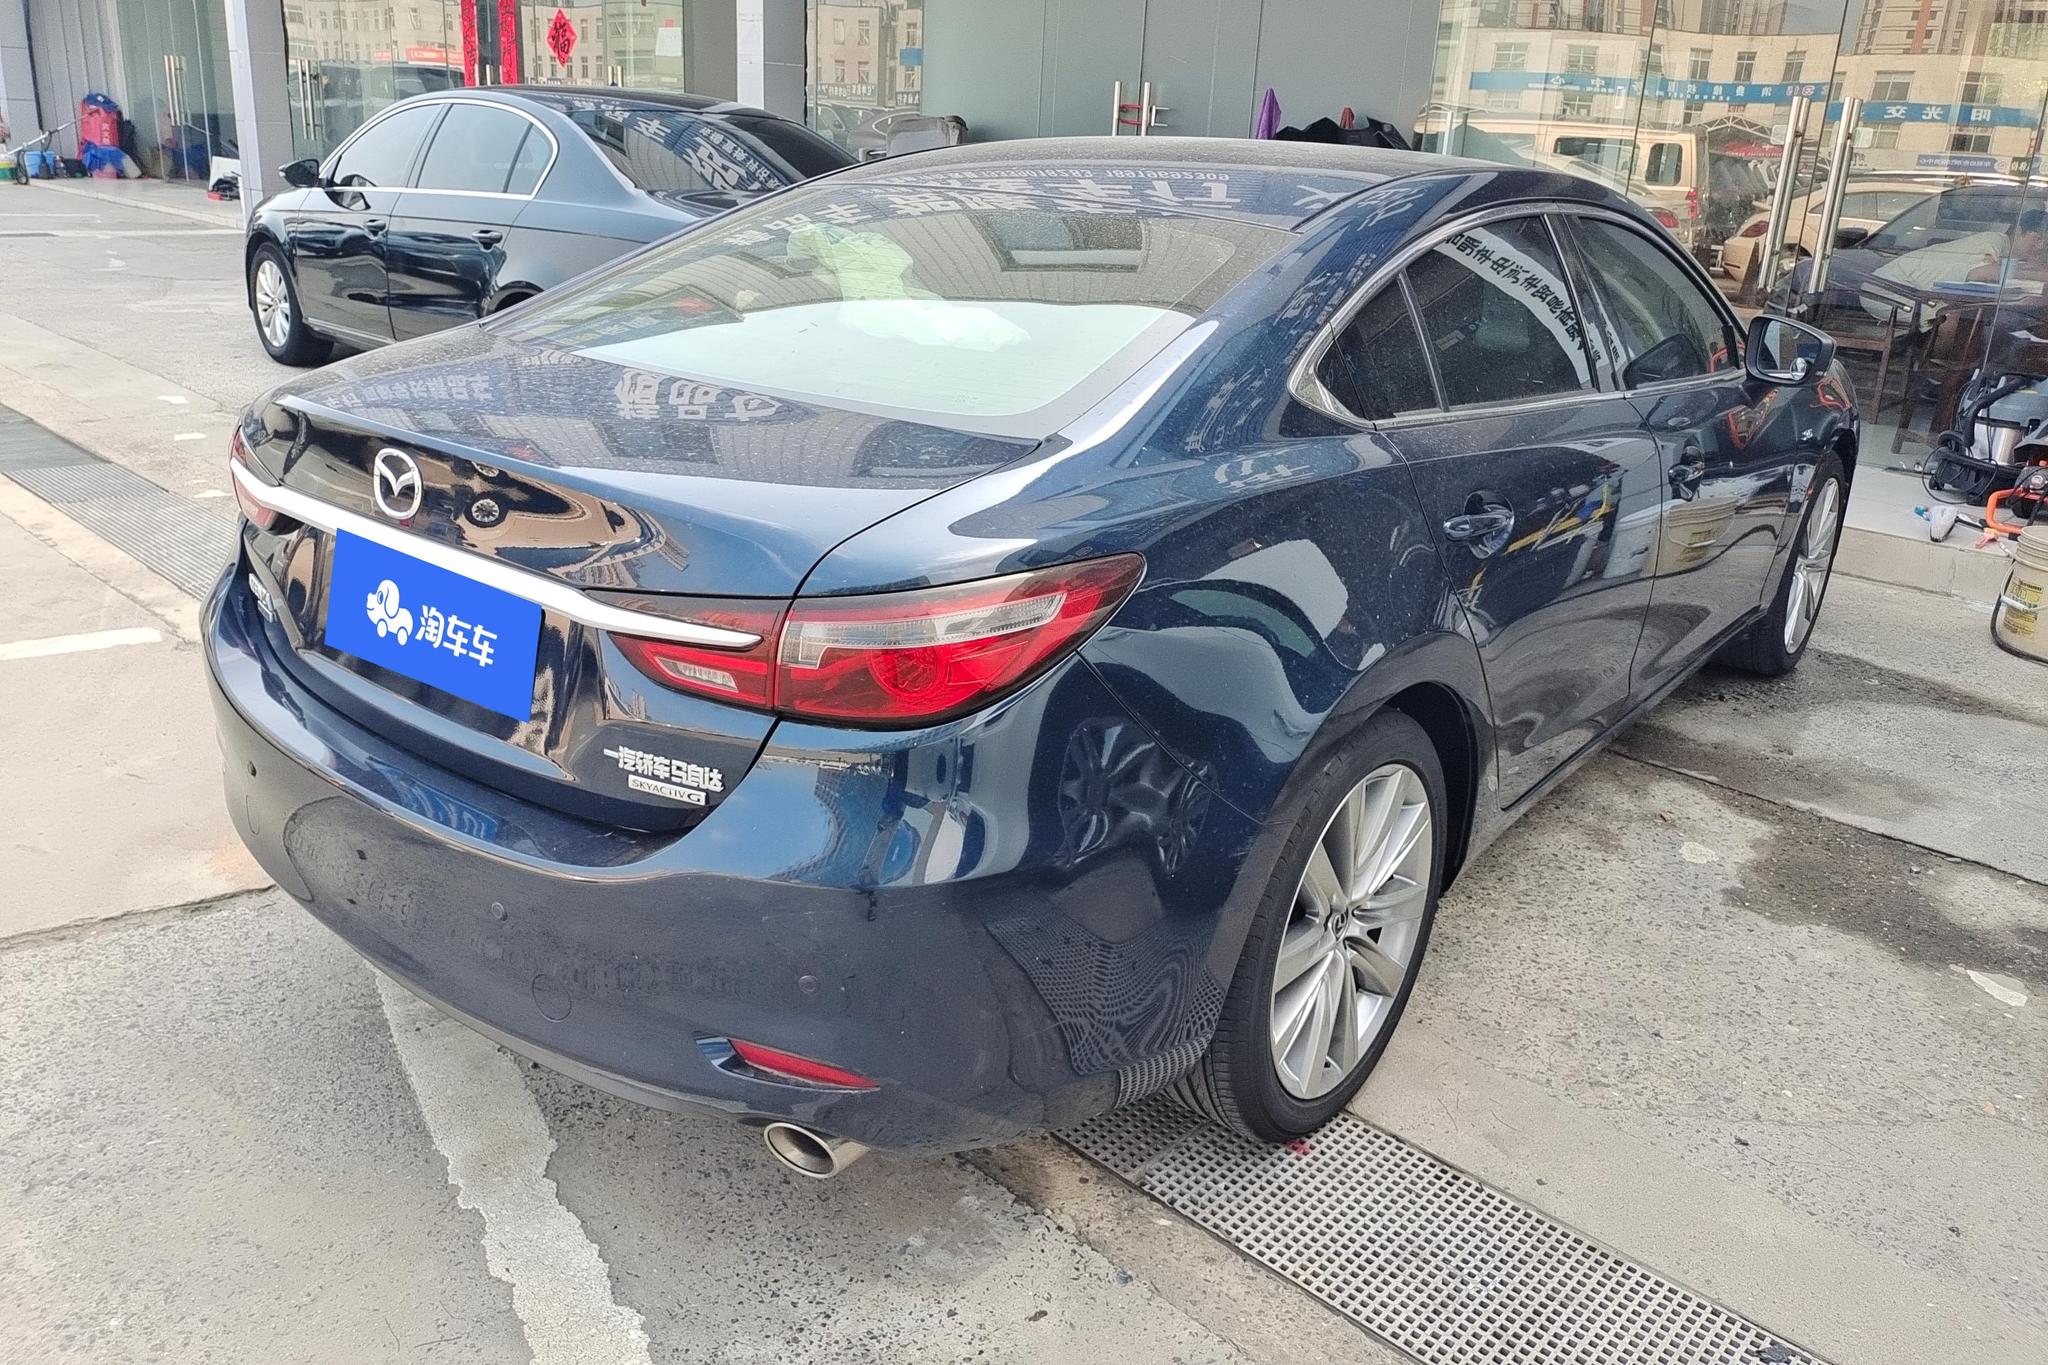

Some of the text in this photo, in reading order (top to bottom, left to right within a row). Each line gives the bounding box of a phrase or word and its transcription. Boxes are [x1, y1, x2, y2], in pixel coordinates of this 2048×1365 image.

[551, 21, 570, 62] 福
[603, 744, 725, 793] 一汽轿车马自达
